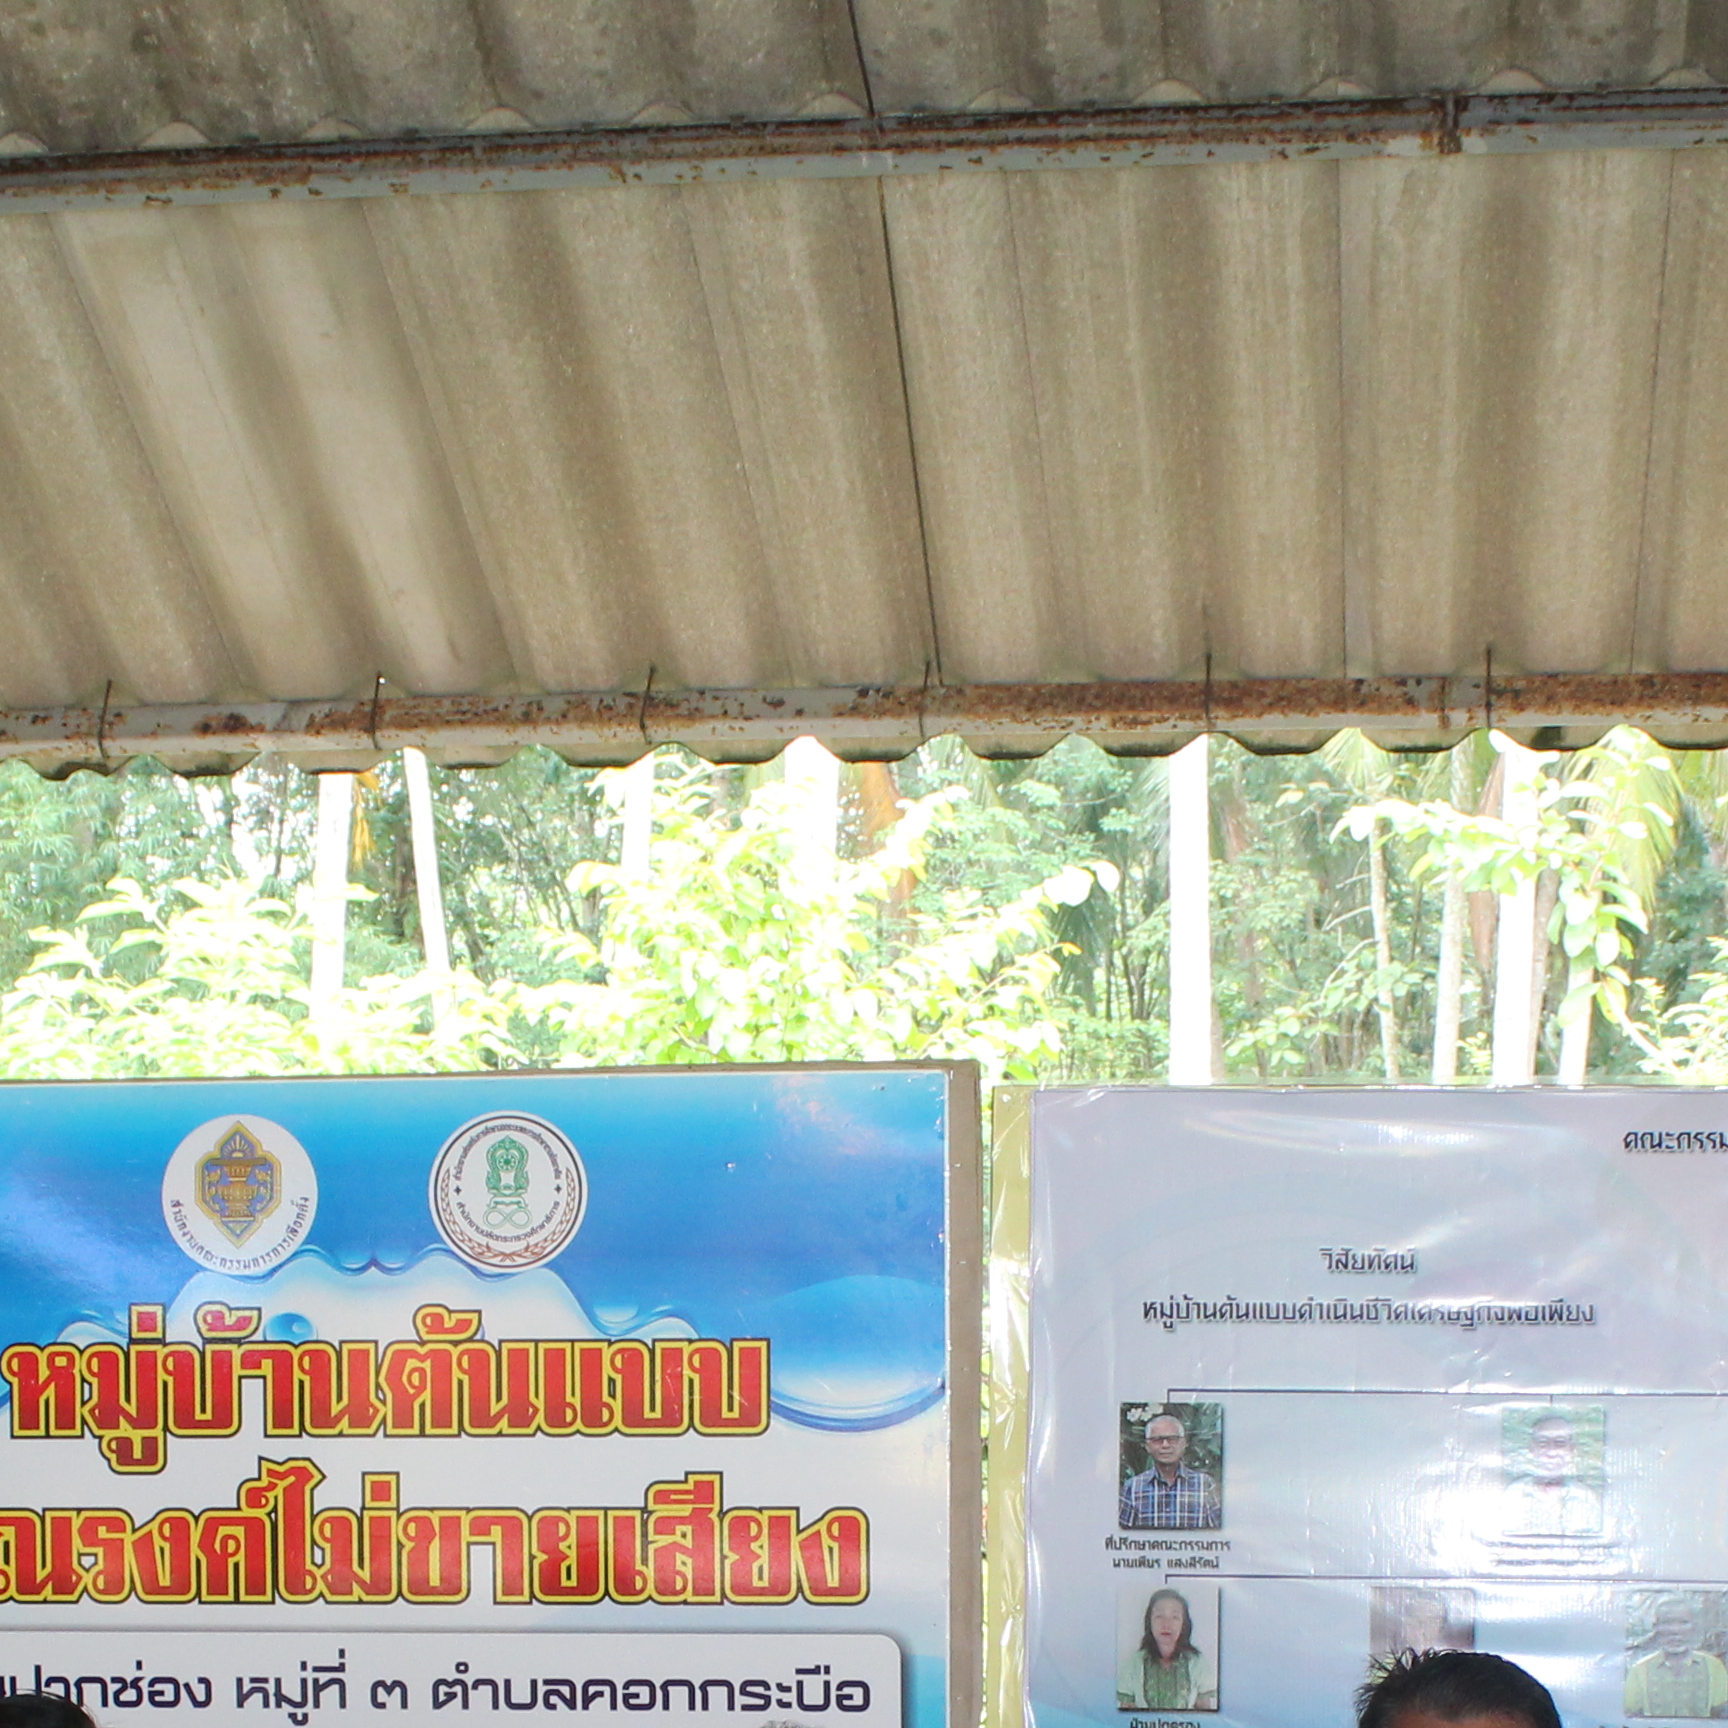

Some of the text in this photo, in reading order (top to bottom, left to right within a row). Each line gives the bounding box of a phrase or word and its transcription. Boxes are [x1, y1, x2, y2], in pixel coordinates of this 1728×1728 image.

[1319, 1246, 1417, 1273] วิสัยทัศน์
[0, 1301, 773, 1474] หมู่บ้านต้นแบบ
[235, 1648, 347, 1726] หมู่ที่
[370, 1678, 409, 1711] ๓
[432, 1661, 872, 1713] ตำบลคอกกระบือ
